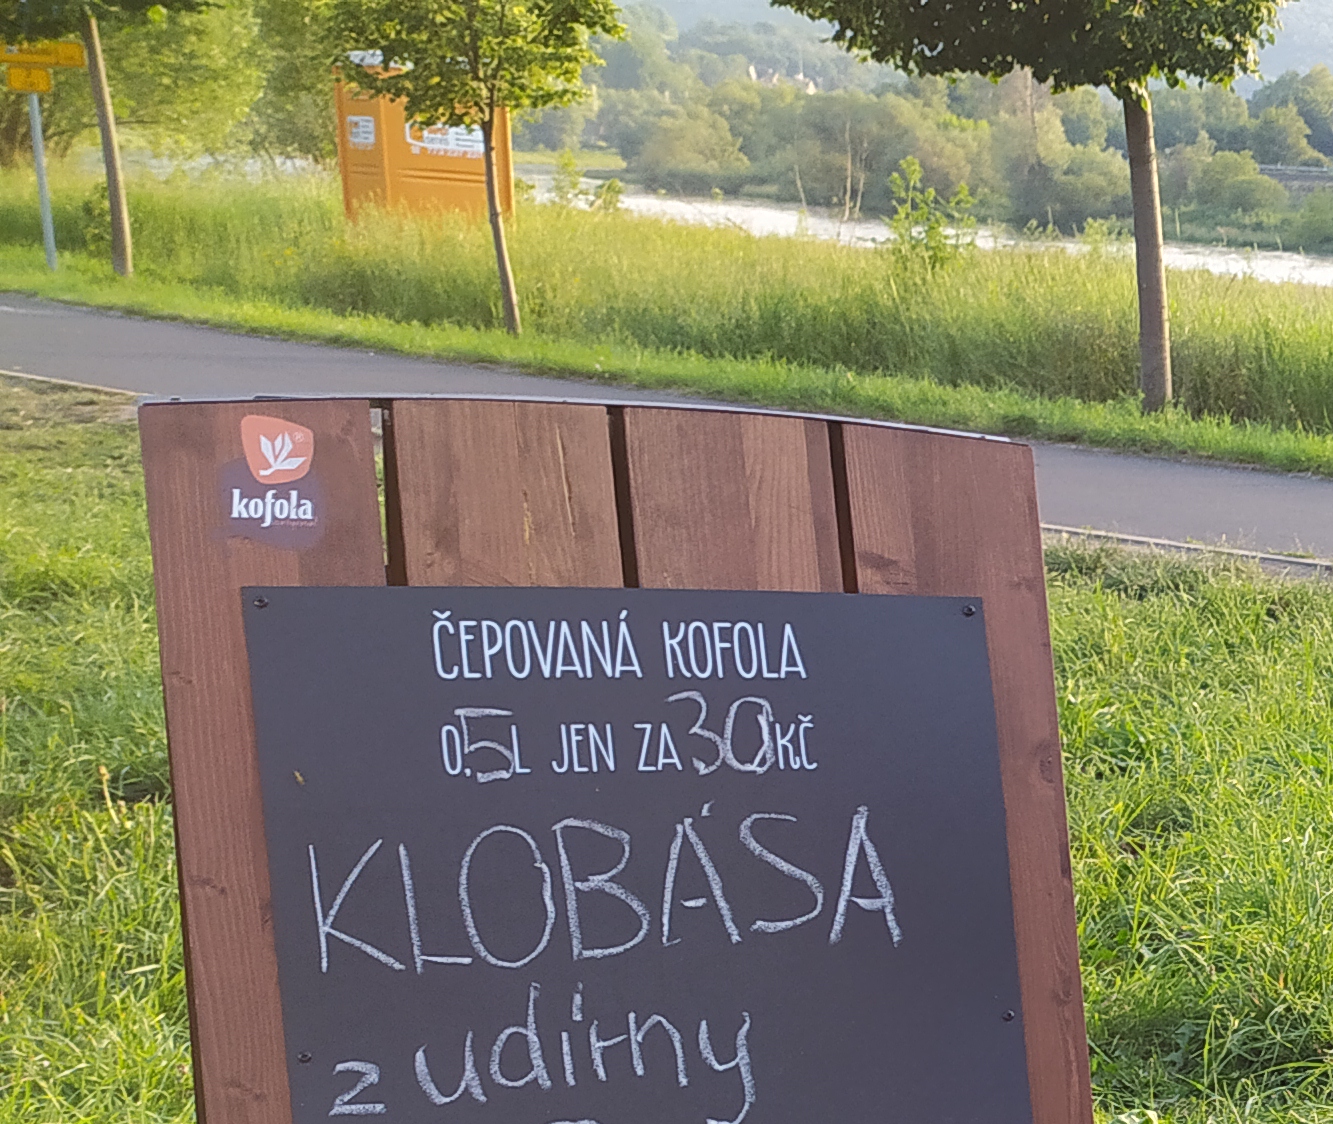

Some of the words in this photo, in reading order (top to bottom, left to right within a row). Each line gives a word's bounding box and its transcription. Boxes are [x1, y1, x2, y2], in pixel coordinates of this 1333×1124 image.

[230, 488, 315, 528] kofola
[432, 609, 643, 680] ČEPOVANÁ
[662, 621, 808, 680] KOFOLA
[551, 722, 616, 773] JEN
[308, 800, 904, 976] KLOBÁSA
[328, 1059, 387, 1117] z
